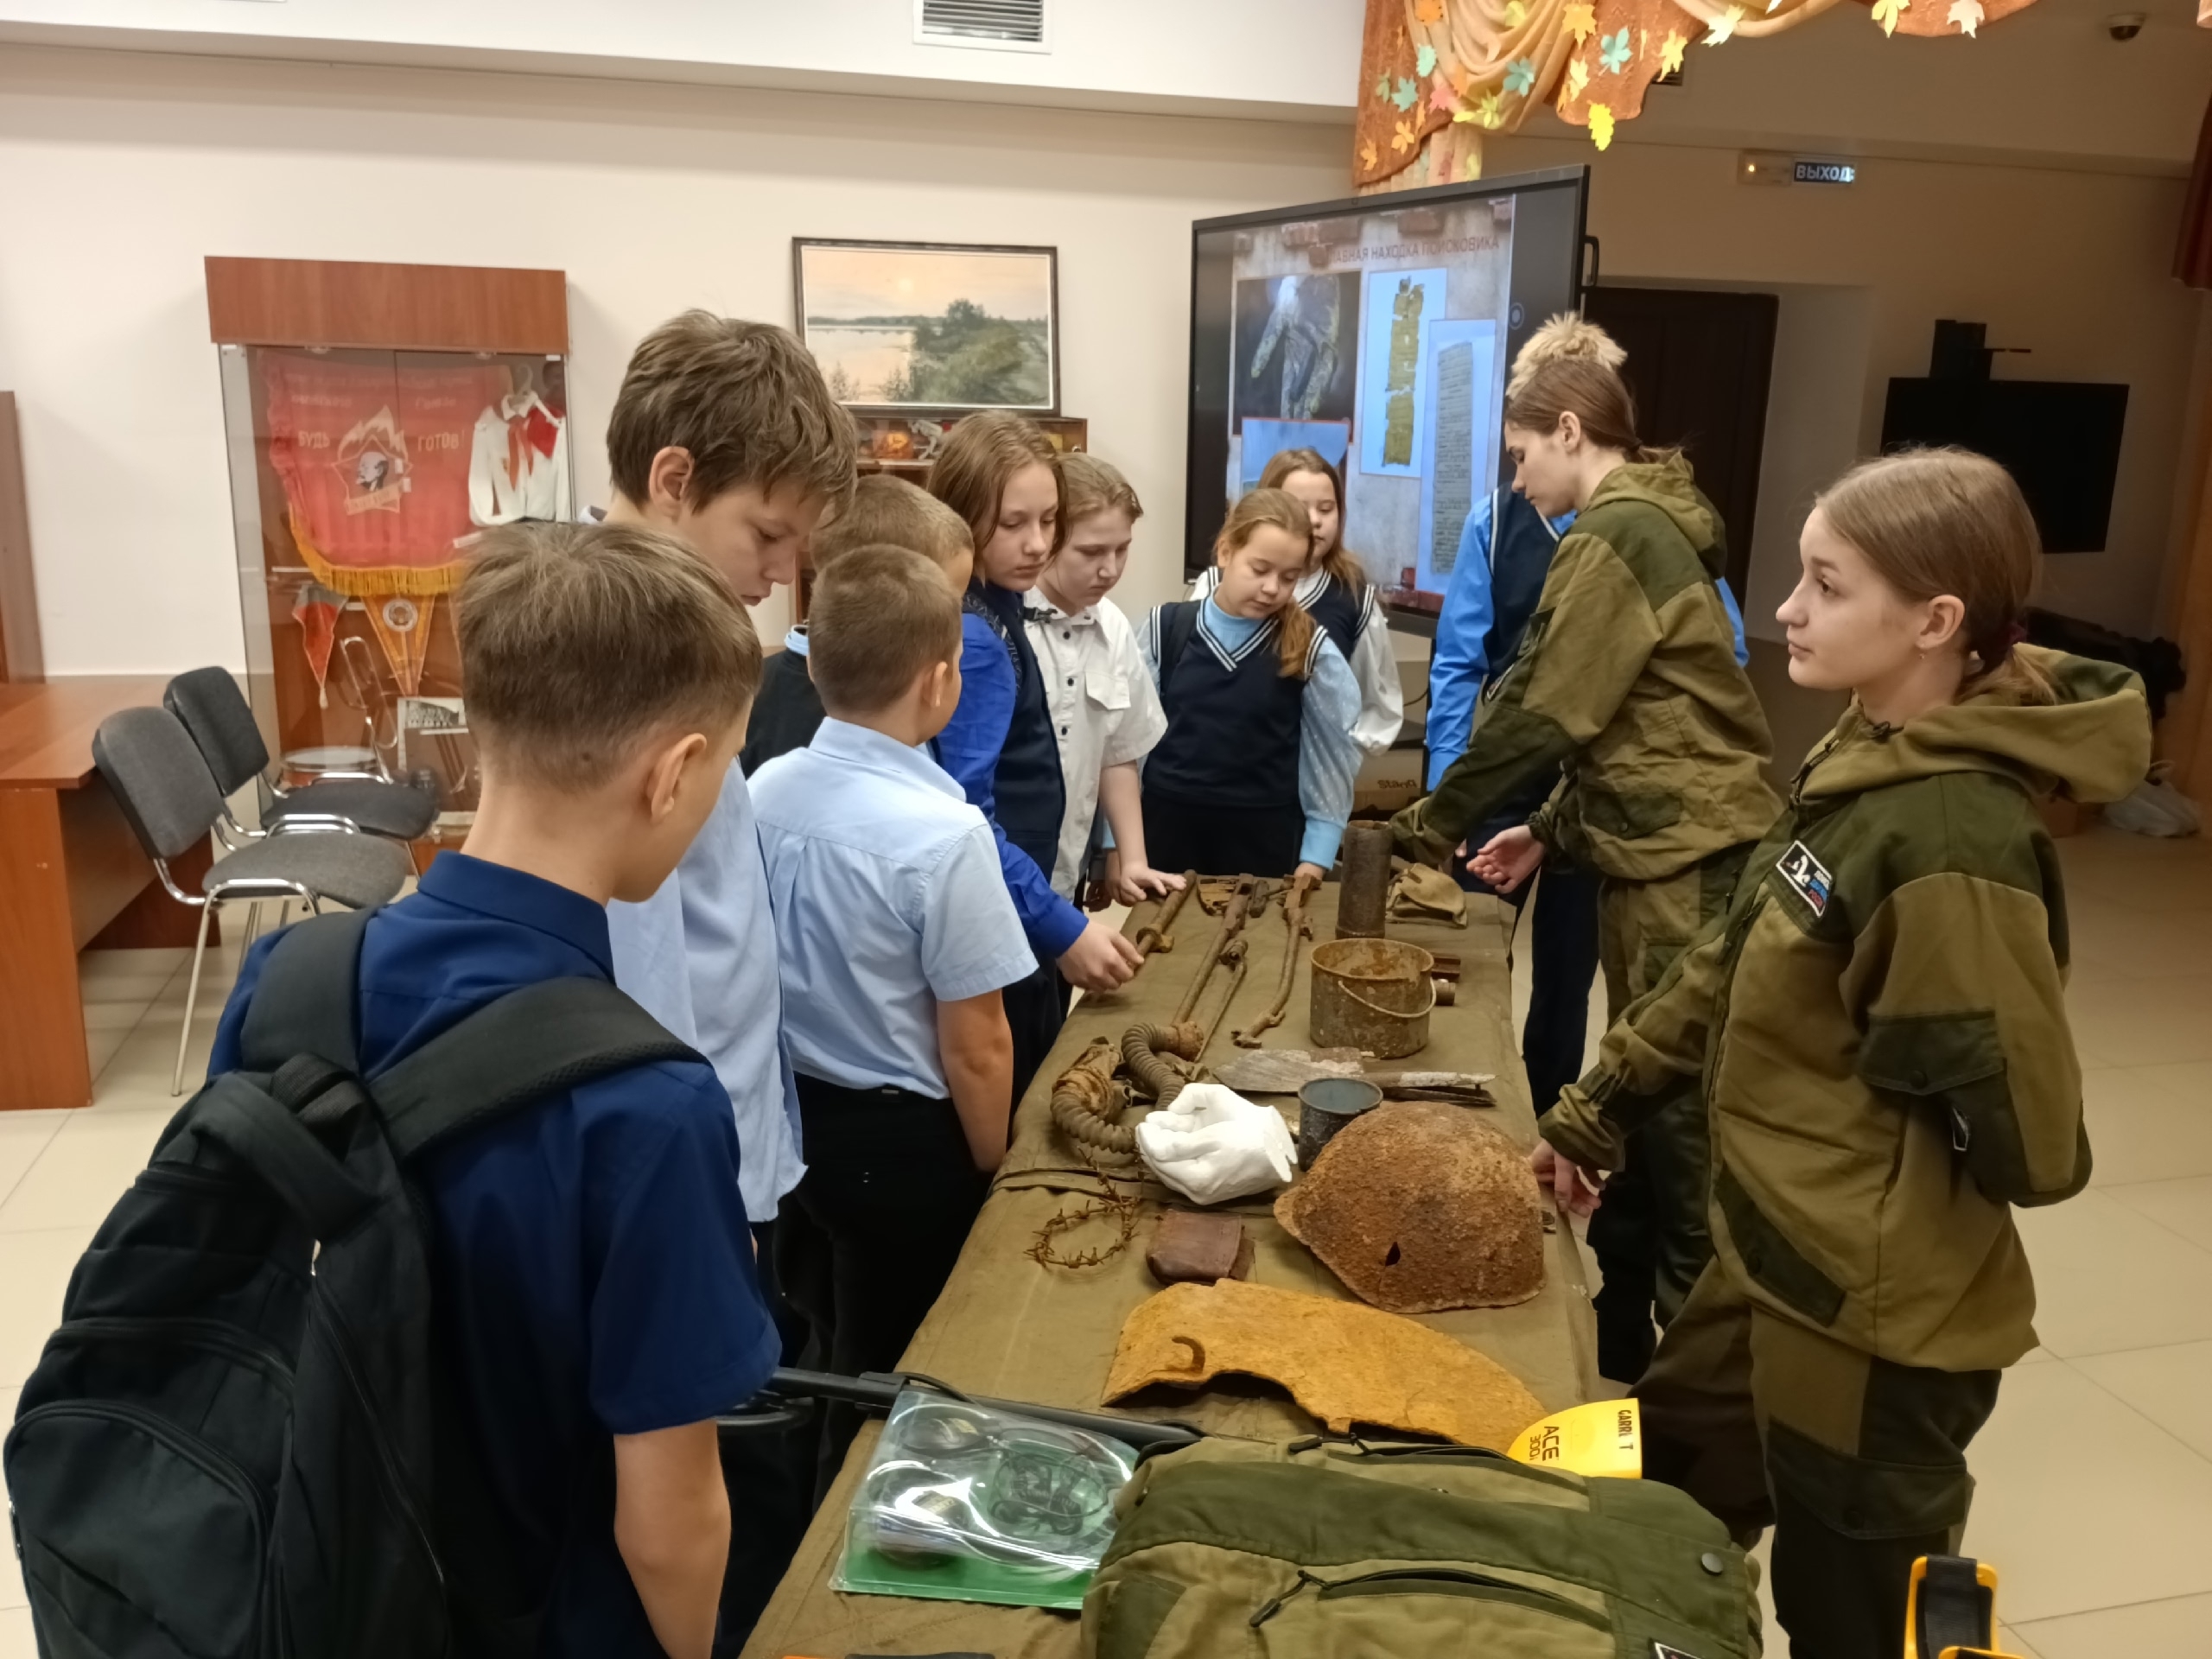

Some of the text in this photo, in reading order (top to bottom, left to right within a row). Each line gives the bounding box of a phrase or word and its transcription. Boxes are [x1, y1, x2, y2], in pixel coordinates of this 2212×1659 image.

[1796, 164, 1854, 182] ВЫХОД
[1370, 244, 1419, 261] НАХОДКА
[1421, 235, 1500, 257] ПОИСКОВИКА
[297, 430, 330, 449] БУДЬ
[1541, 1426, 1560, 1461] ACE
